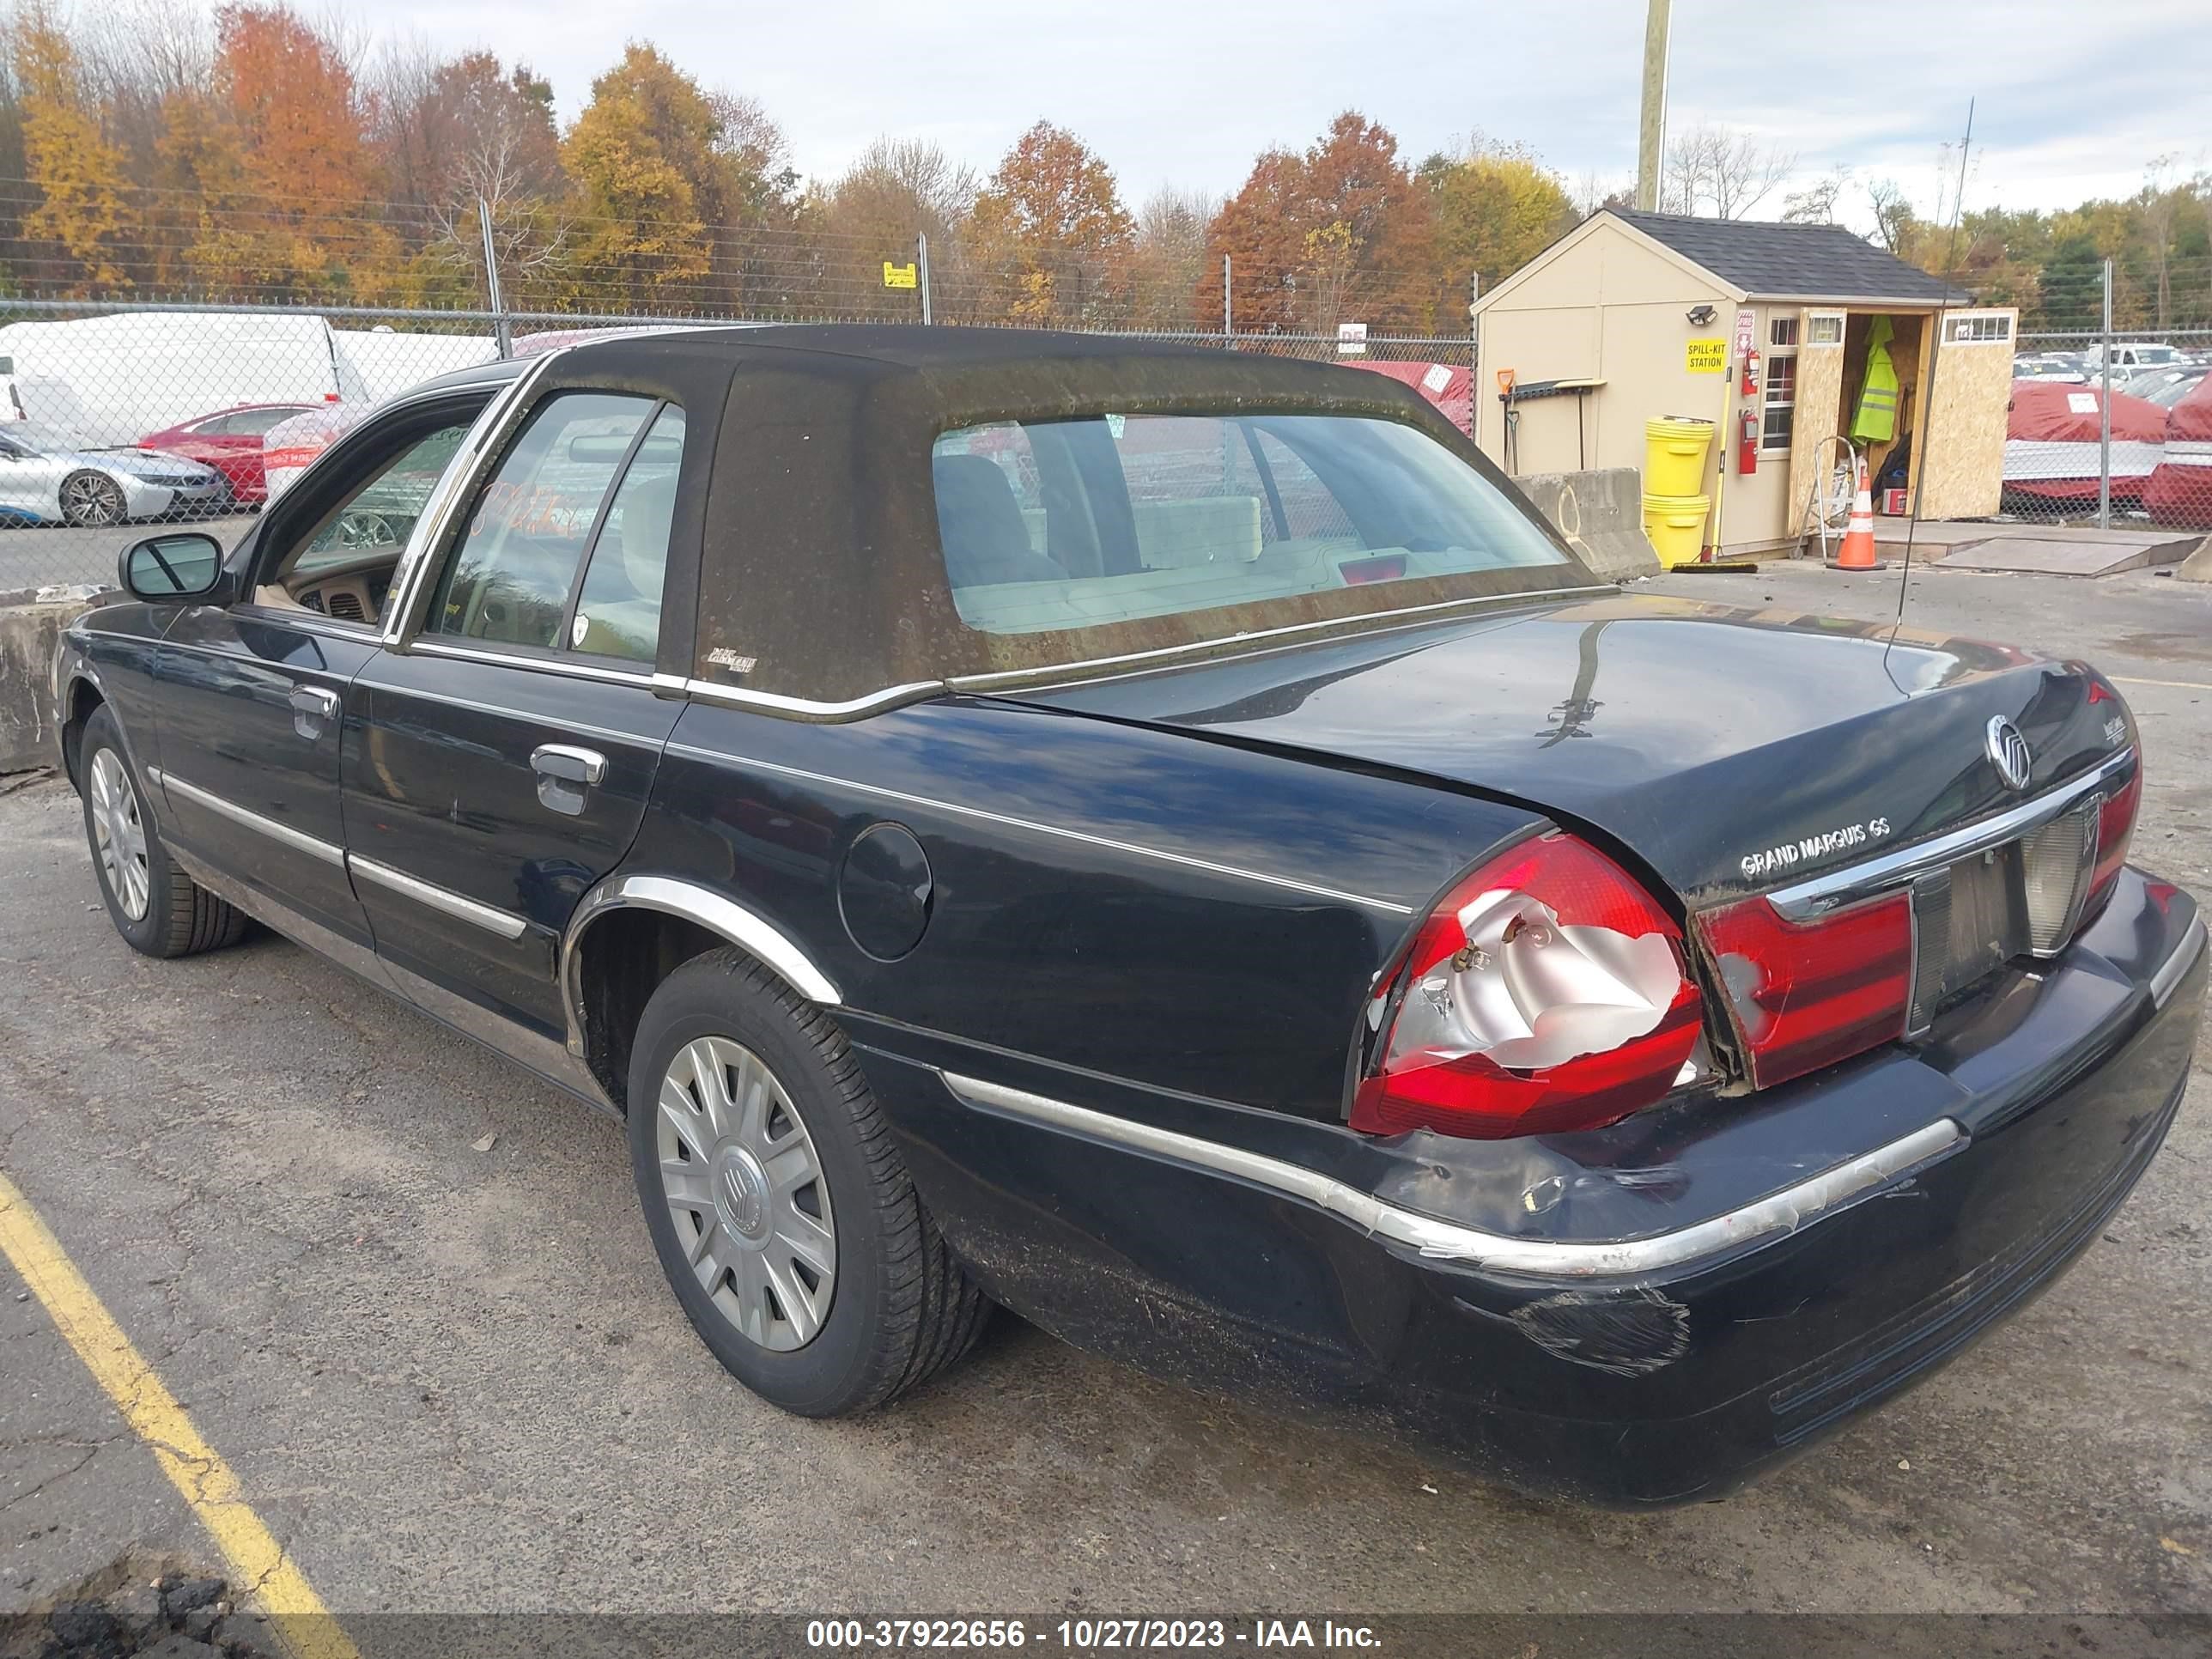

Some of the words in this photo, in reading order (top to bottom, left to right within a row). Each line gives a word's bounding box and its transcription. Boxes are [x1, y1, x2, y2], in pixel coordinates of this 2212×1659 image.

[1688, 344, 1726, 355] SPILL-KIT
[1690, 357, 1723, 368] STATION
[1741, 844, 1799, 875] GRAND
[1799, 824, 1866, 860] MARQUIS
[1869, 817, 1891, 837] GS
